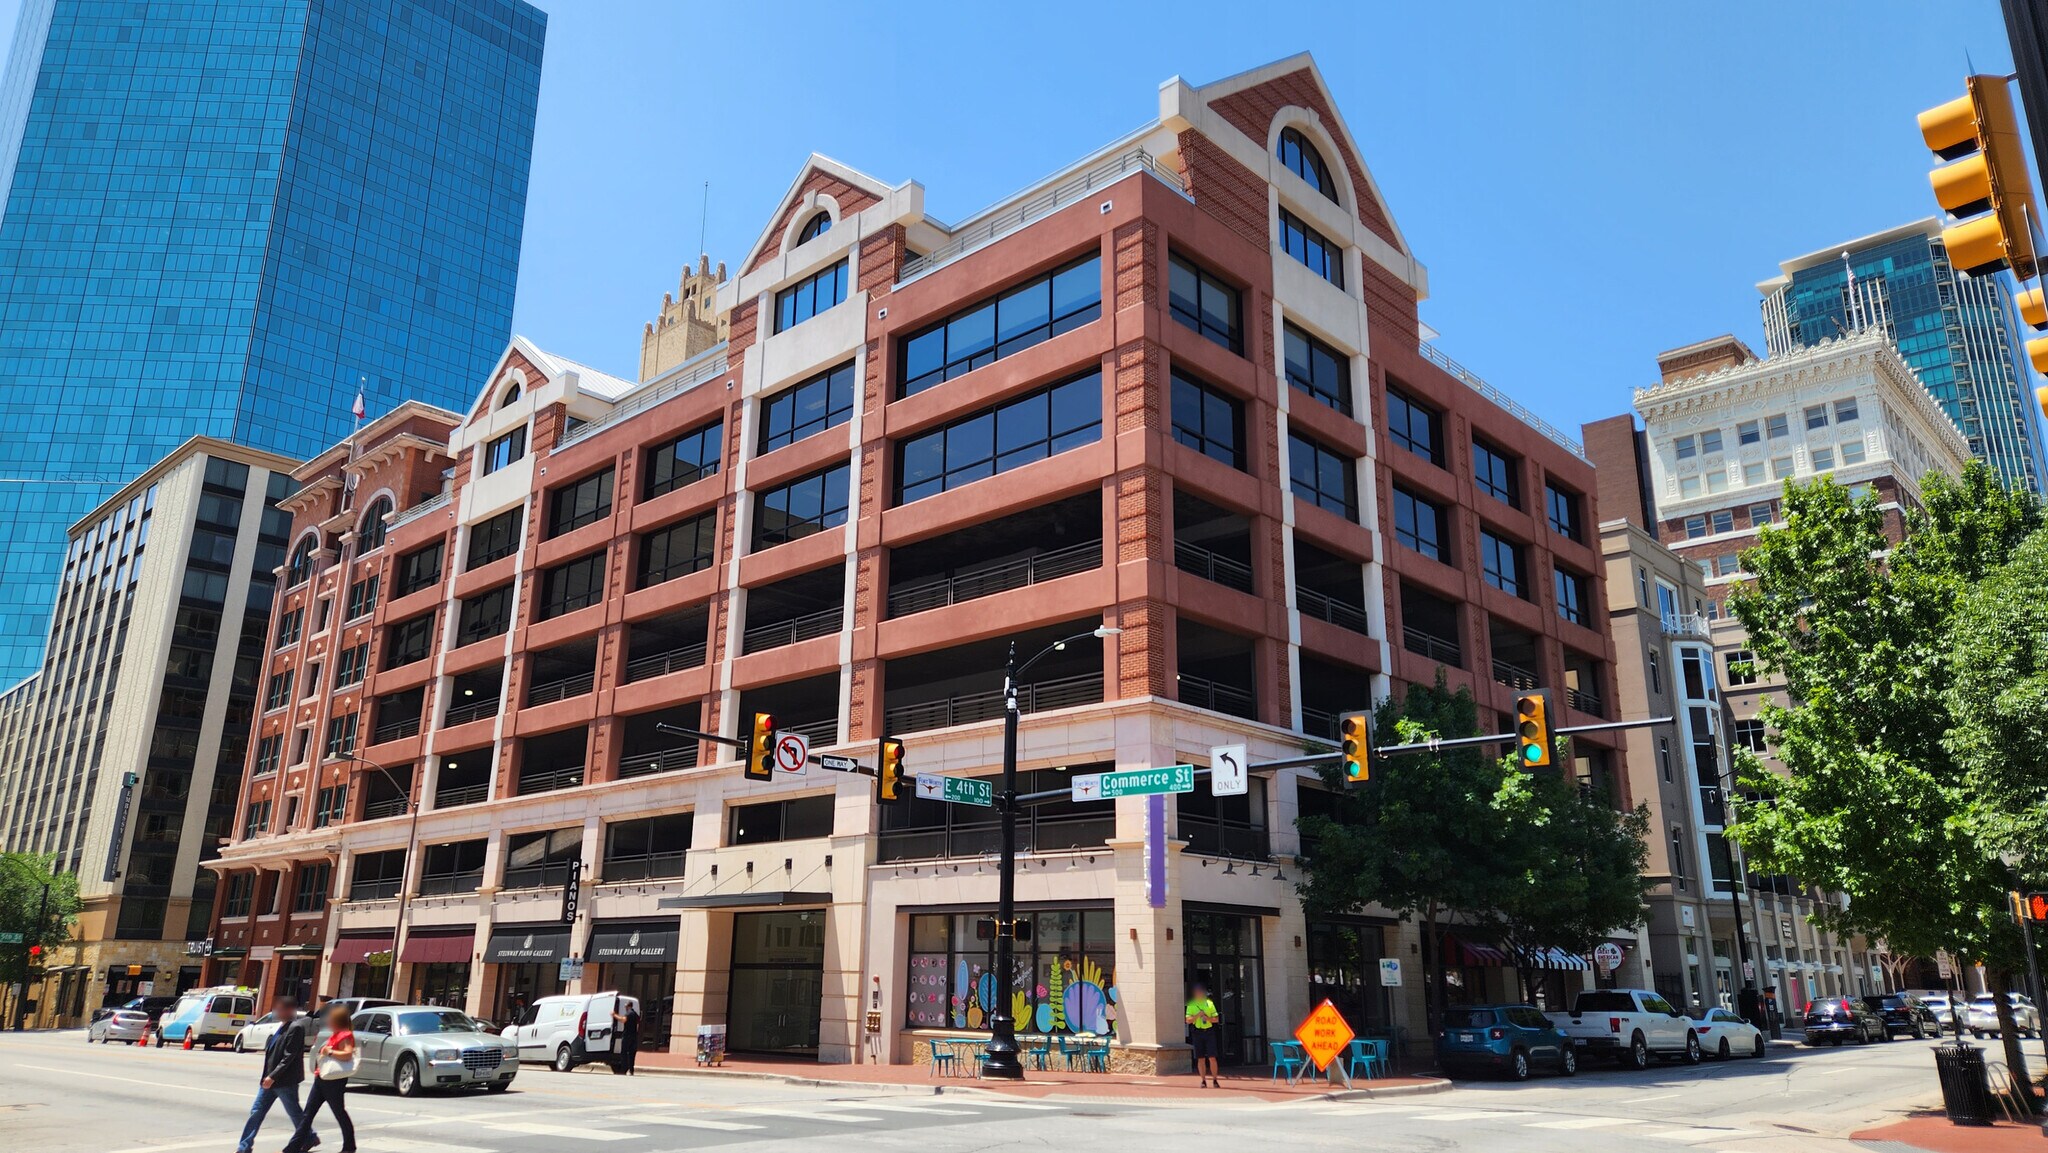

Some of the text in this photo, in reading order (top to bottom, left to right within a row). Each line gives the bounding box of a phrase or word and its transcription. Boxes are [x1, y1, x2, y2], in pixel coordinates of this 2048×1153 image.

[1102, 768, 1190, 790] Commerce St
[946, 779, 990, 798] E 4th St
[1218, 780, 1242, 791] ONLY
[567, 861, 580, 921] PIANOS
[1316, 1017, 1337, 1025] ROAD
[1315, 1030, 1336, 1038] WORK
[1312, 1042, 1339, 1050] AHEAD
